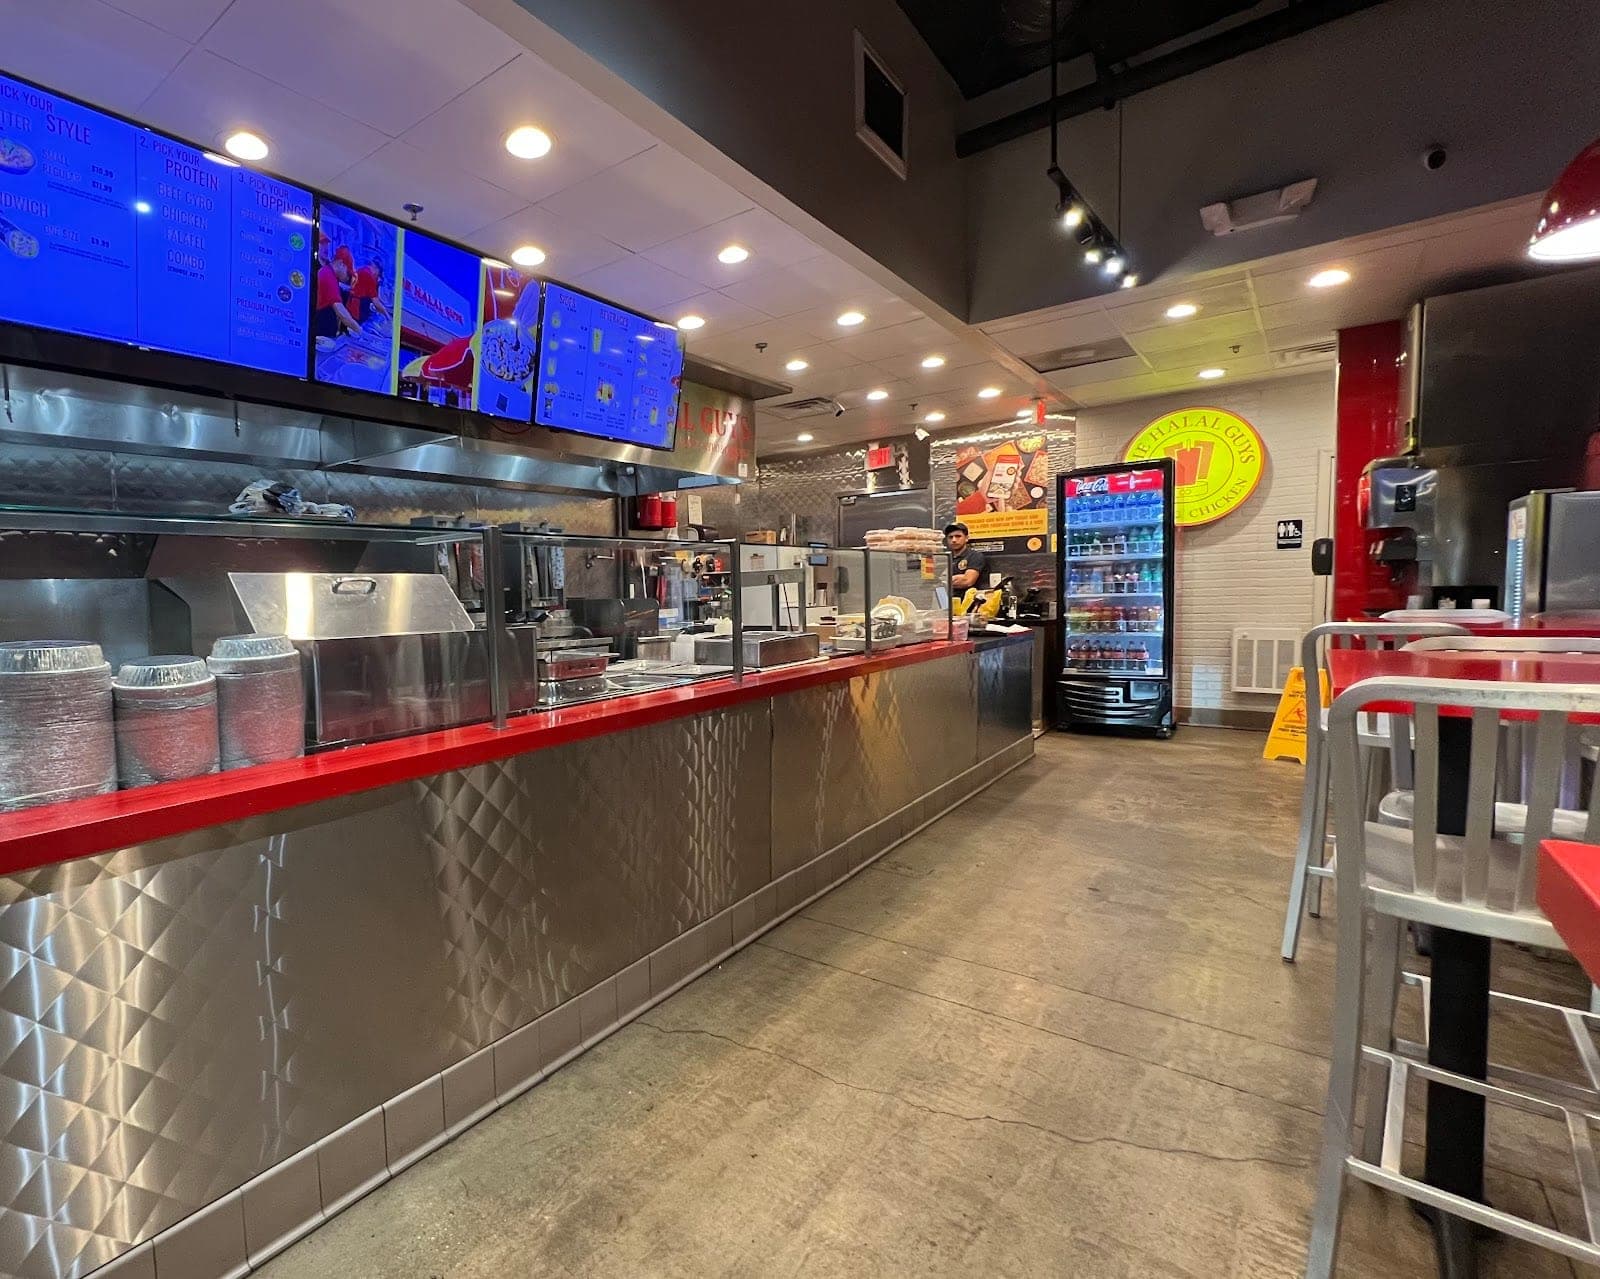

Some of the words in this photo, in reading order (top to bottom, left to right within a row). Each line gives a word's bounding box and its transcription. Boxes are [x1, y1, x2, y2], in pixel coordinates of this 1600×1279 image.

[23, 91, 53, 113] YOUR
[46, 114, 91, 146] STYLE
[153, 140, 174, 159] PICK
[176, 149, 200, 167] YOUR
[165, 159, 219, 192] PROTEIN
[249, 178, 267, 193] PICK
[269, 182, 289, 200] YOUR
[158, 182, 183, 202] BEEF
[185, 191, 213, 212] GYRO
[255, 190, 308, 218] TOPPINGS
[162, 204, 208, 230] CHICKEN
[166, 228, 205, 250] FALAFEL
[167, 249, 205, 271] COMBO
[1149, 415, 1221, 443] HALAL
[1224, 425, 1256, 465] GUYS
[1189, 478, 1248, 519] CHICKEN
